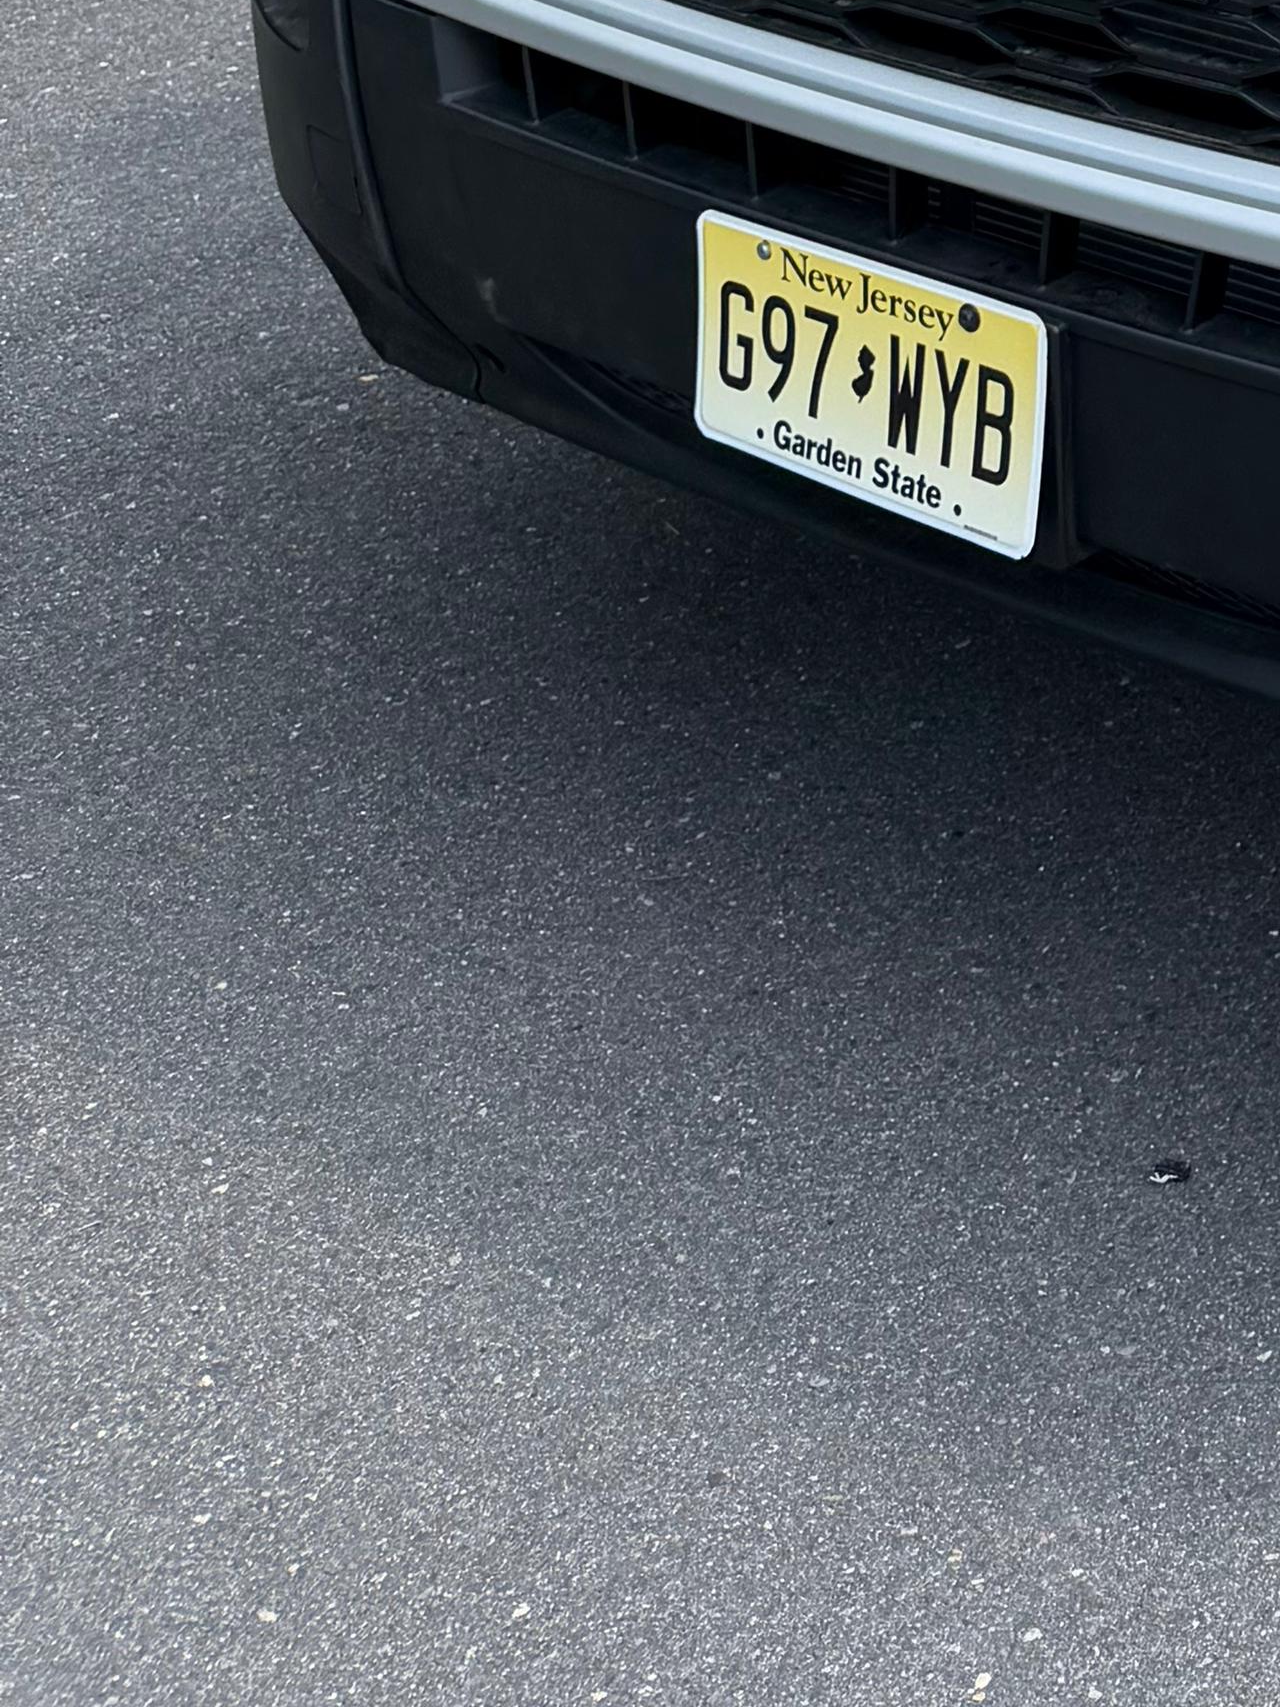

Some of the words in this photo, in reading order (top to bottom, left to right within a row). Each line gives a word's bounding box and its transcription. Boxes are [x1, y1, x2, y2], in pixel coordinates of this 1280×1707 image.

[780, 246, 853, 302] New
[856, 272, 955, 343] Jersey
[718, 280, 840, 420] G97
[887, 334, 1015, 487] WYB
[773, 420, 862, 480] Garden
[872, 457, 942, 510] State
